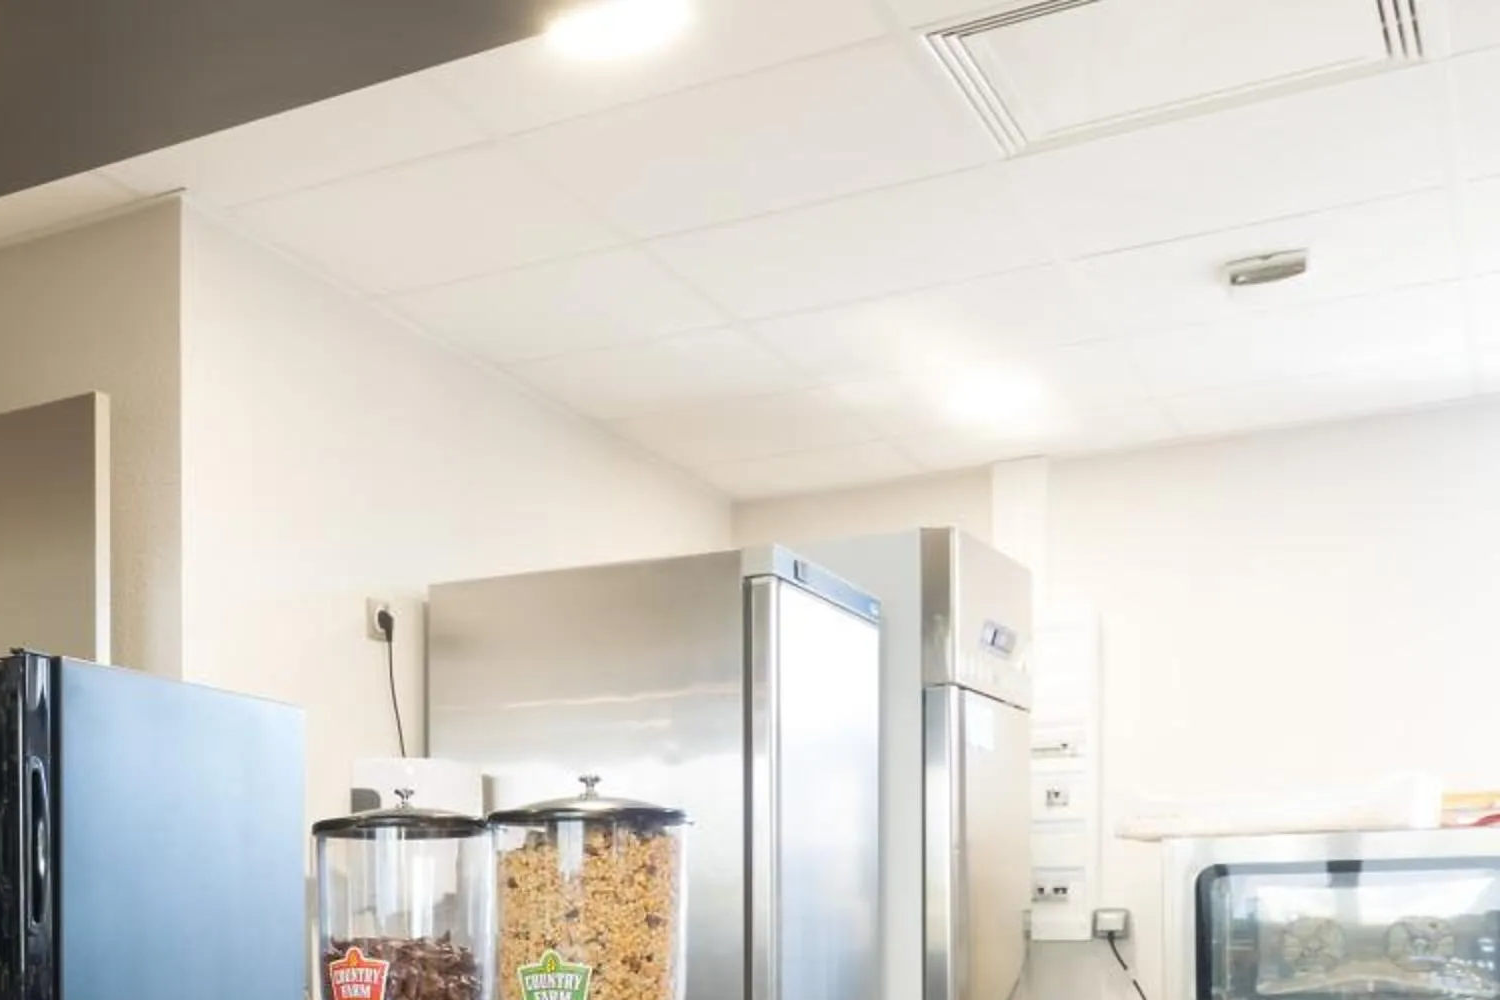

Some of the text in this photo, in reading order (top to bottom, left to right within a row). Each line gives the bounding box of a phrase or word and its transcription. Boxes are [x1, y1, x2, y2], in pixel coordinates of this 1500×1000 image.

[333, 967, 382, 985] COUNTRY
[525, 973, 582, 991] COUNTRY
[341, 984, 371, 999] FARM
